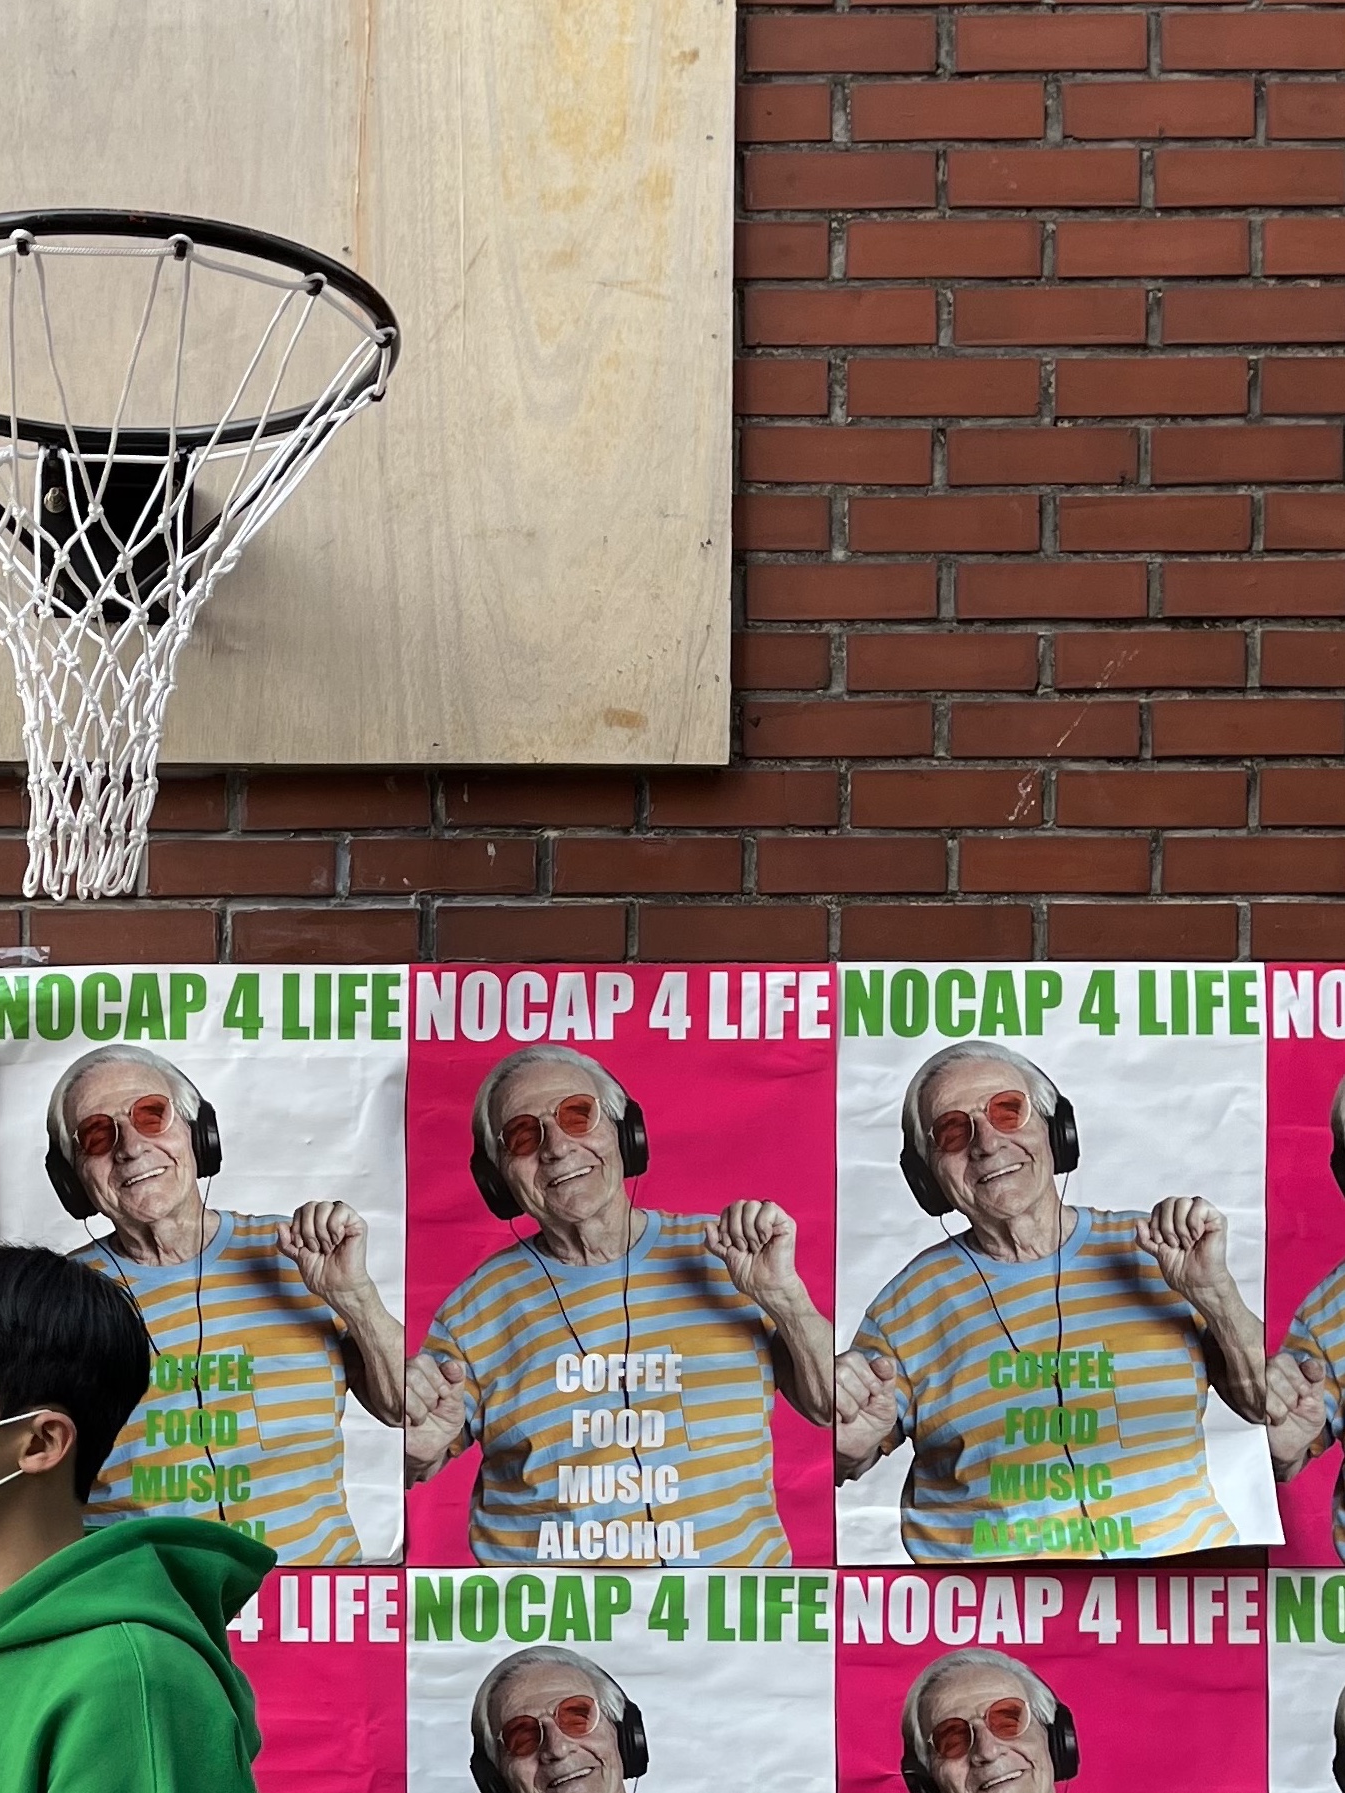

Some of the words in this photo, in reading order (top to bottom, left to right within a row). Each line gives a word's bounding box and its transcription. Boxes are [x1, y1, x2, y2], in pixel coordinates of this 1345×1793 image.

[224, 973, 263, 1040] 4
[281, 973, 401, 1040] LIFE
[416, 971, 634, 1041] NOCAP
[649, 973, 691, 1039] 4
[708, 973, 831, 1039] LIFE
[844, 968, 1062, 1037] NOCAP
[1079, 969, 1119, 1036] 4
[1138, 969, 1260, 1035] LIFE
[149, 1354, 254, 1391] OFFEE
[555, 1354, 682, 1393] COFFEE
[989, 1350, 1115, 1388] COFFEE
[146, 1409, 237, 1446] FOOD
[572, 1410, 665, 1448] FOOD
[1005, 1406, 1097, 1445] FOOD
[132, 1465, 250, 1502] MUSIC
[558, 1466, 679, 1505] MUSIC
[990, 1463, 1111, 1501] MUSIC
[537, 1522, 699, 1560] ALCOHOL
[973, 1516, 1140, 1551] ALCOHOL
[226, 1592, 263, 1642] 4
[280, 1575, 399, 1642] LIFE
[414, 1575, 630, 1642] NOCAP
[649, 1576, 689, 1642] 4
[707, 1576, 828, 1642] LIFE
[842, 1576, 1063, 1645] NOCAP
[1079, 1578, 1121, 1644] 4
[1138, 1577, 1260, 1644] LIFE
